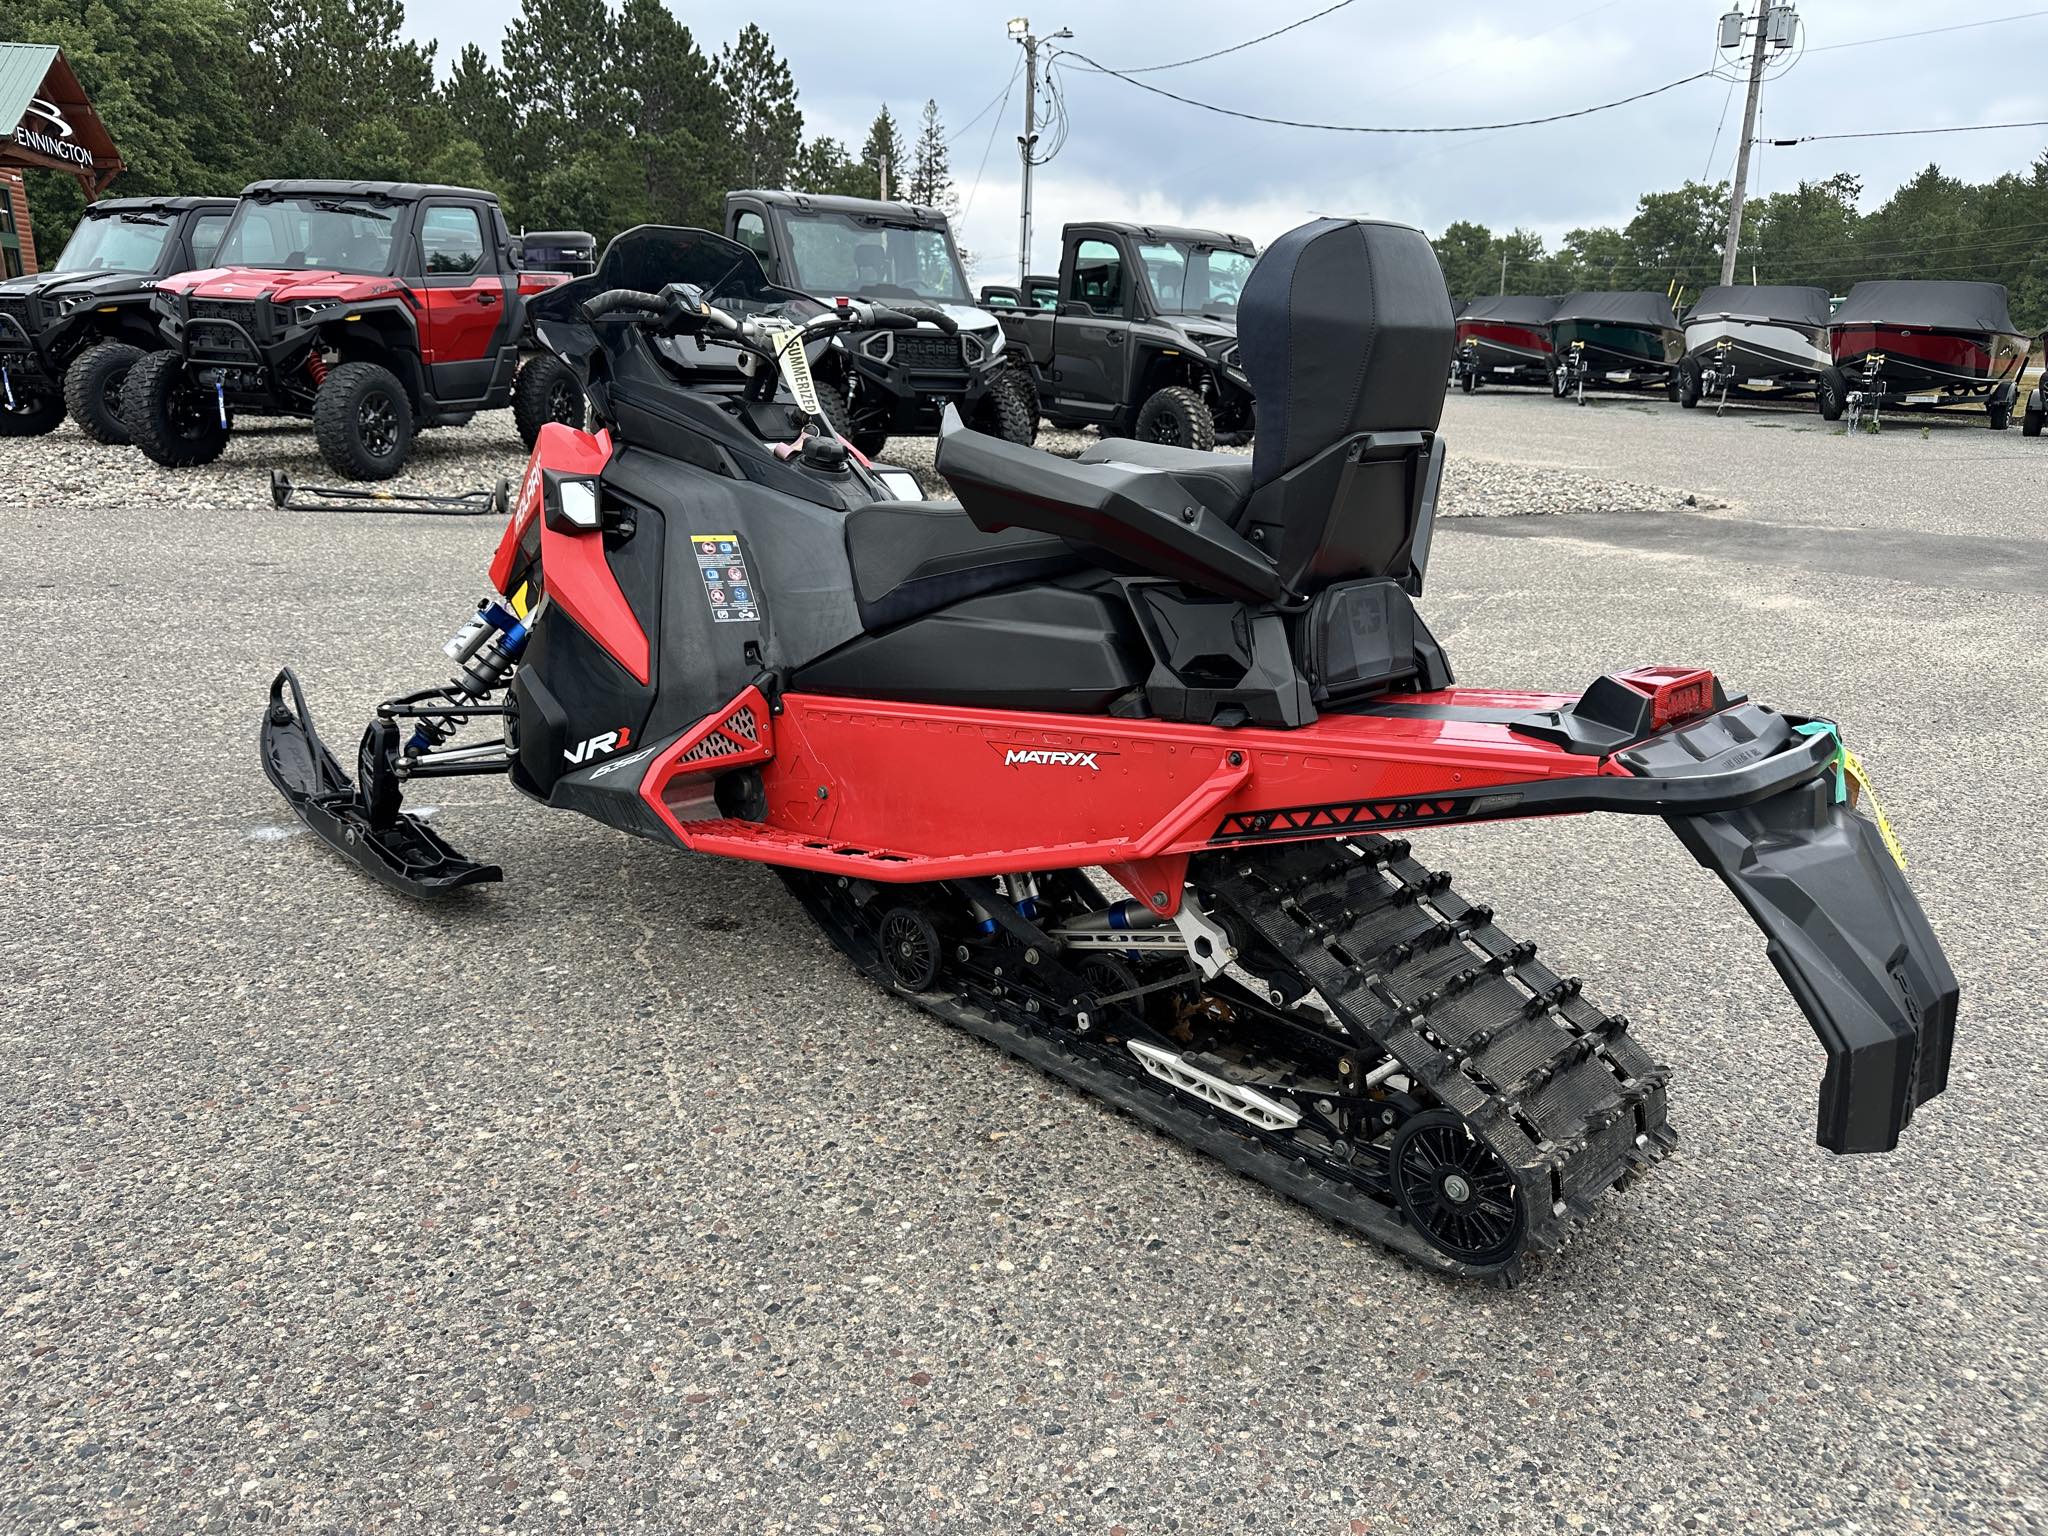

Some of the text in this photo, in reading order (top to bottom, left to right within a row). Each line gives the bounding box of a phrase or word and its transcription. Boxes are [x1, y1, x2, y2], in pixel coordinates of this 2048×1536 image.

[15, 126, 93, 165] ENNINGTON
[896, 342, 958, 355] POLARIS
[786, 340, 817, 413] SUMMERIZED
[514, 451, 541, 536] POLARI
[563, 727, 631, 764] VR1
[1004, 749, 1101, 771] MATRYX
